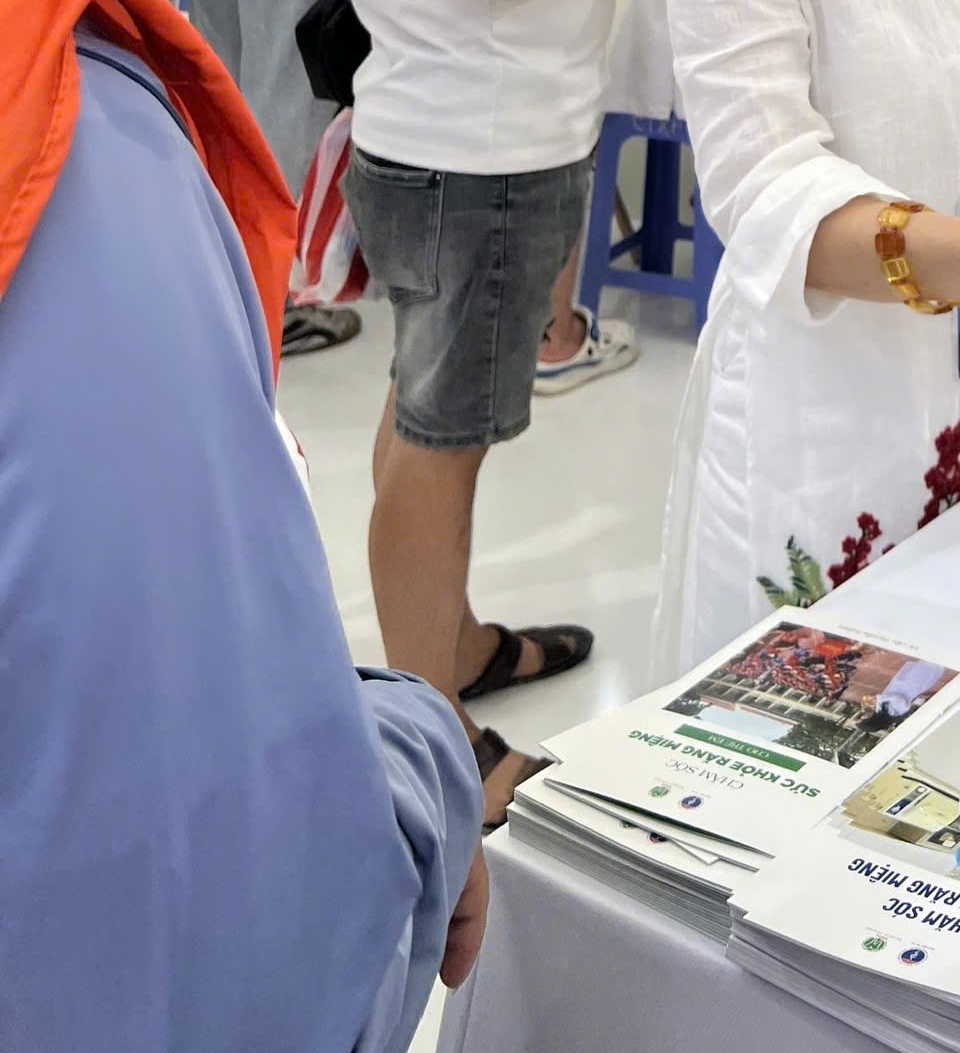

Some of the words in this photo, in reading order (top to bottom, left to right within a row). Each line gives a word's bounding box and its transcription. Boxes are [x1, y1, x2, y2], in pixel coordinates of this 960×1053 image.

[628, 730, 683, 752] MIỆNG
[681, 746, 732, 767] RĂNG
[729, 761, 781, 784] KHỎE
[780, 776, 821, 798] SỨC
[847, 858, 909, 888] MIỆNG
[882, 897, 924, 919] SÓC
